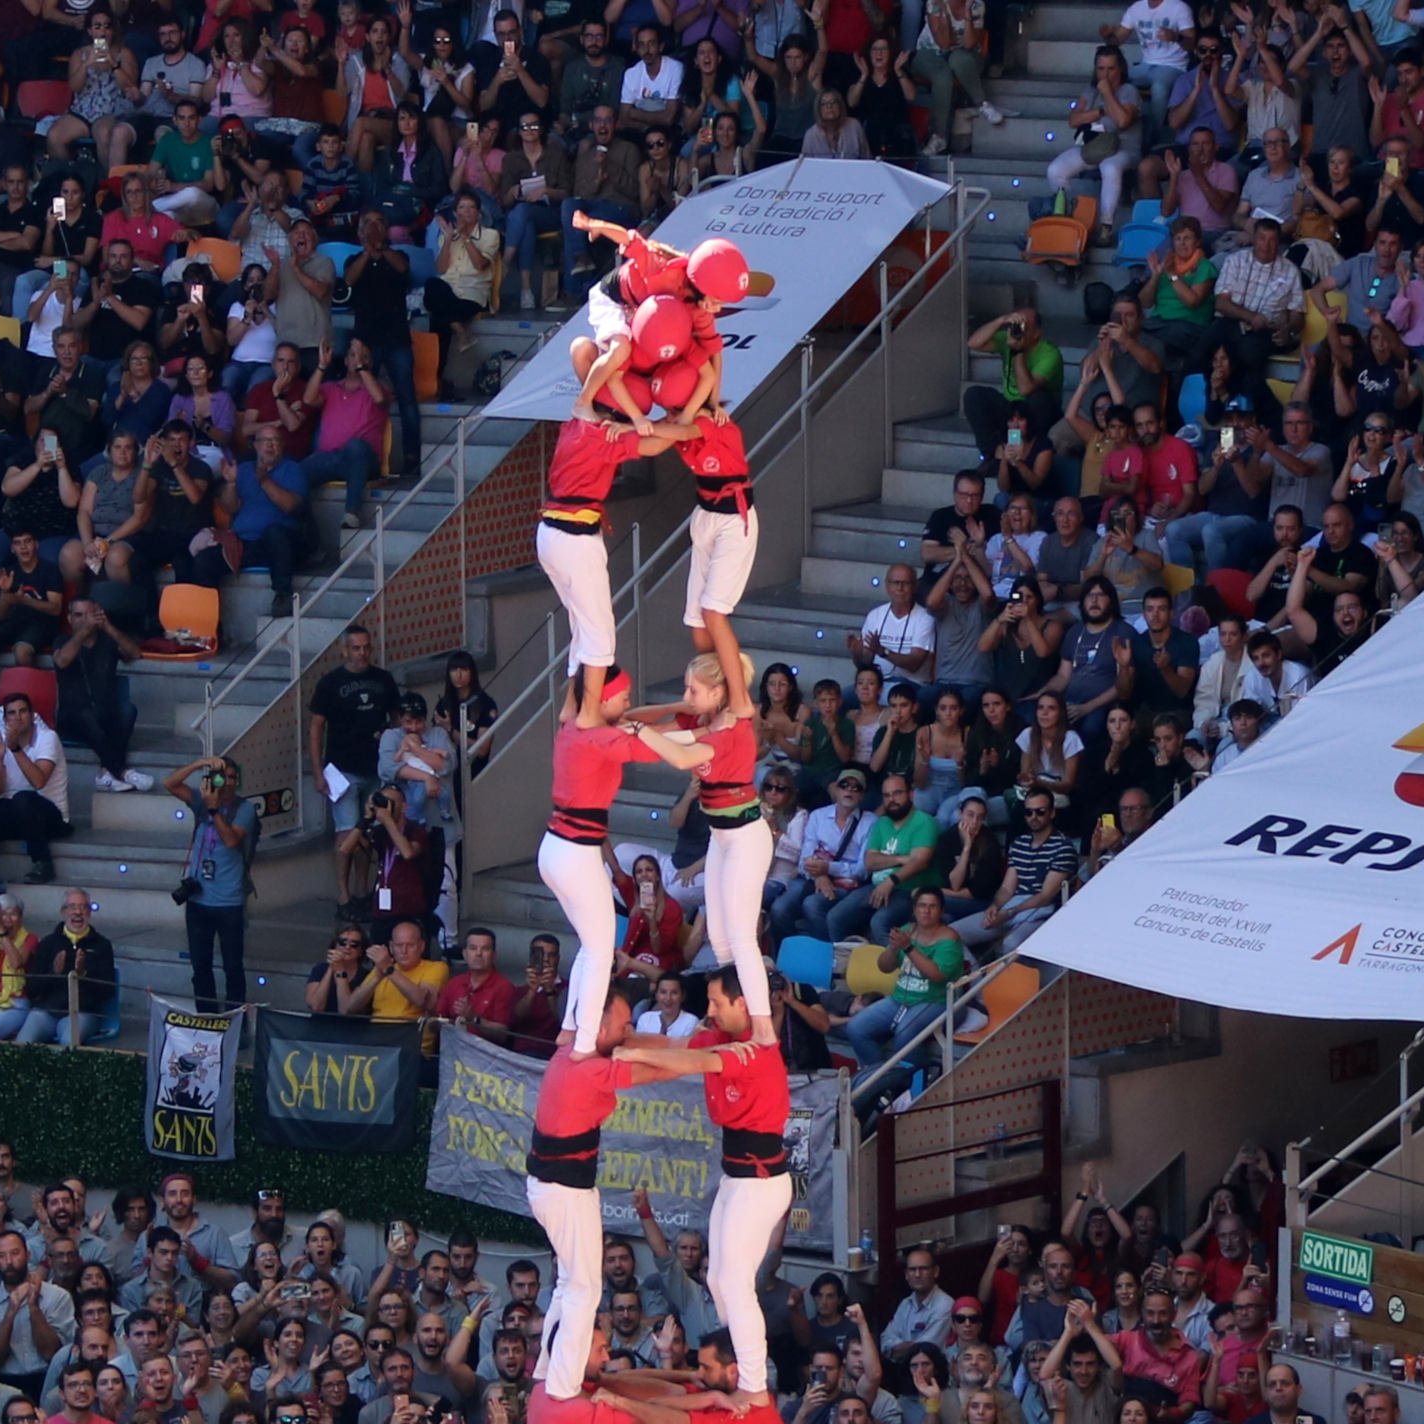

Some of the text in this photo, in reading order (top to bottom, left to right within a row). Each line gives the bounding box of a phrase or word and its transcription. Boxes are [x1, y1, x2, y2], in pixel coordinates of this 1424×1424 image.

[733, 186, 887, 206] Donem suport
[719, 202, 858, 221] a la tradició i
[705, 219, 807, 238] la cultura
[1161, 887, 1249, 912] Patrocinador
[1145, 903, 1208, 923] principal
[1207, 914, 1232, 928] del
[1133, 915, 1267, 952] Concurs de Castells
[167, 1013, 230, 1031] CASTELLERS
[279, 1050, 379, 1114] SANTS
[153, 1110, 218, 1156] SANTS
[1303, 1238, 1368, 1279] SORTIDA
[1306, 1282, 1357, 1302] ZONA SENSE FUM
